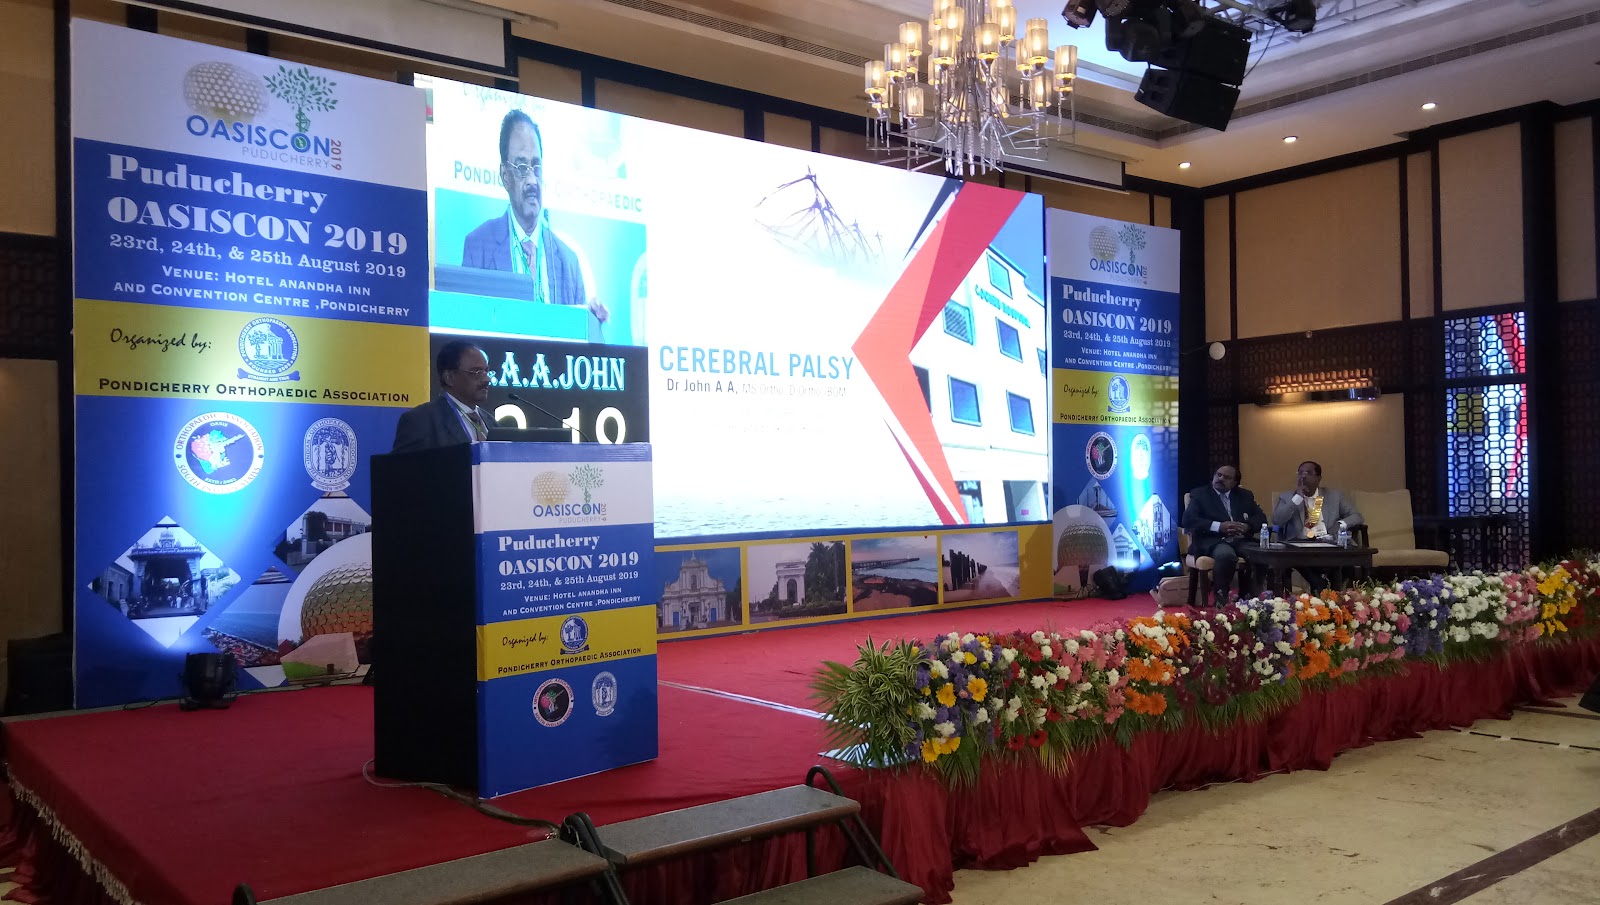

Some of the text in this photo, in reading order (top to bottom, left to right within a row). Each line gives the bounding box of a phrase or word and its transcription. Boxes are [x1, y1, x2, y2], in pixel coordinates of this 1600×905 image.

[186, 115, 330, 156] OASISCON
[242, 146, 330, 169] PUDUCHERRY
[330, 139, 342, 171] 2019
[108, 154, 328, 214] Puducherry
[108, 196, 408, 256] OASISCON 2019
[110, 234, 406, 278] 23rd, 24th, & 25th August 2019
[1090, 258, 1142, 278] OASISCON
[162, 265, 370, 296] VENUE: HOTEL ANANDHA INN
[114, 281, 146, 294] AND
[152, 283, 248, 302] CONVENTION
[254, 292, 310, 308] CENTRE
[1062, 284, 1142, 312] Puducherry
[1062, 308, 1172, 334] OASISCON 2019
[110, 328, 212, 353] Organized by:
[1064, 330, 1171, 348] 23rd, 24th, & 25th August 2019
[659, 345, 854, 380] CEREBRAL PALSY
[1078, 358, 1112, 366] CONVENTION
[1114, 361, 1134, 369] CENTRE
[1104, 348, 1122, 356] HOTEL
[1122, 351, 1147, 359] ANANDHA
[100, 378, 410, 402] PONDICHERRY ORTHOPAEDIC ASSOCIATION
[666, 378, 679, 392] Dr
[684, 379, 711, 393] John
[716, 380, 723, 394] A
[1064, 384, 1090, 398] Organized
[1060, 413, 1099, 422] PONDICHERRY
[1100, 414, 1137, 423] ORTHOPAEDIC
[533, 502, 601, 518] OASISCON
[498, 534, 600, 552] Puducherry
[498, 551, 640, 576] OASISCON 2019
[500, 570, 639, 591] 23rd, 24th, & 25th August 2019
[553, 592, 576, 600] HOTEL
[578, 588, 609, 597] ANANDHA
[520, 604, 565, 615] CONVENTION
[566, 600, 593, 609] CENTRE
[502, 632, 549, 648] Organized by:
[498, 648, 642, 674] PONDICHERRY ORTHOPAEDIC ASSOCIATION
